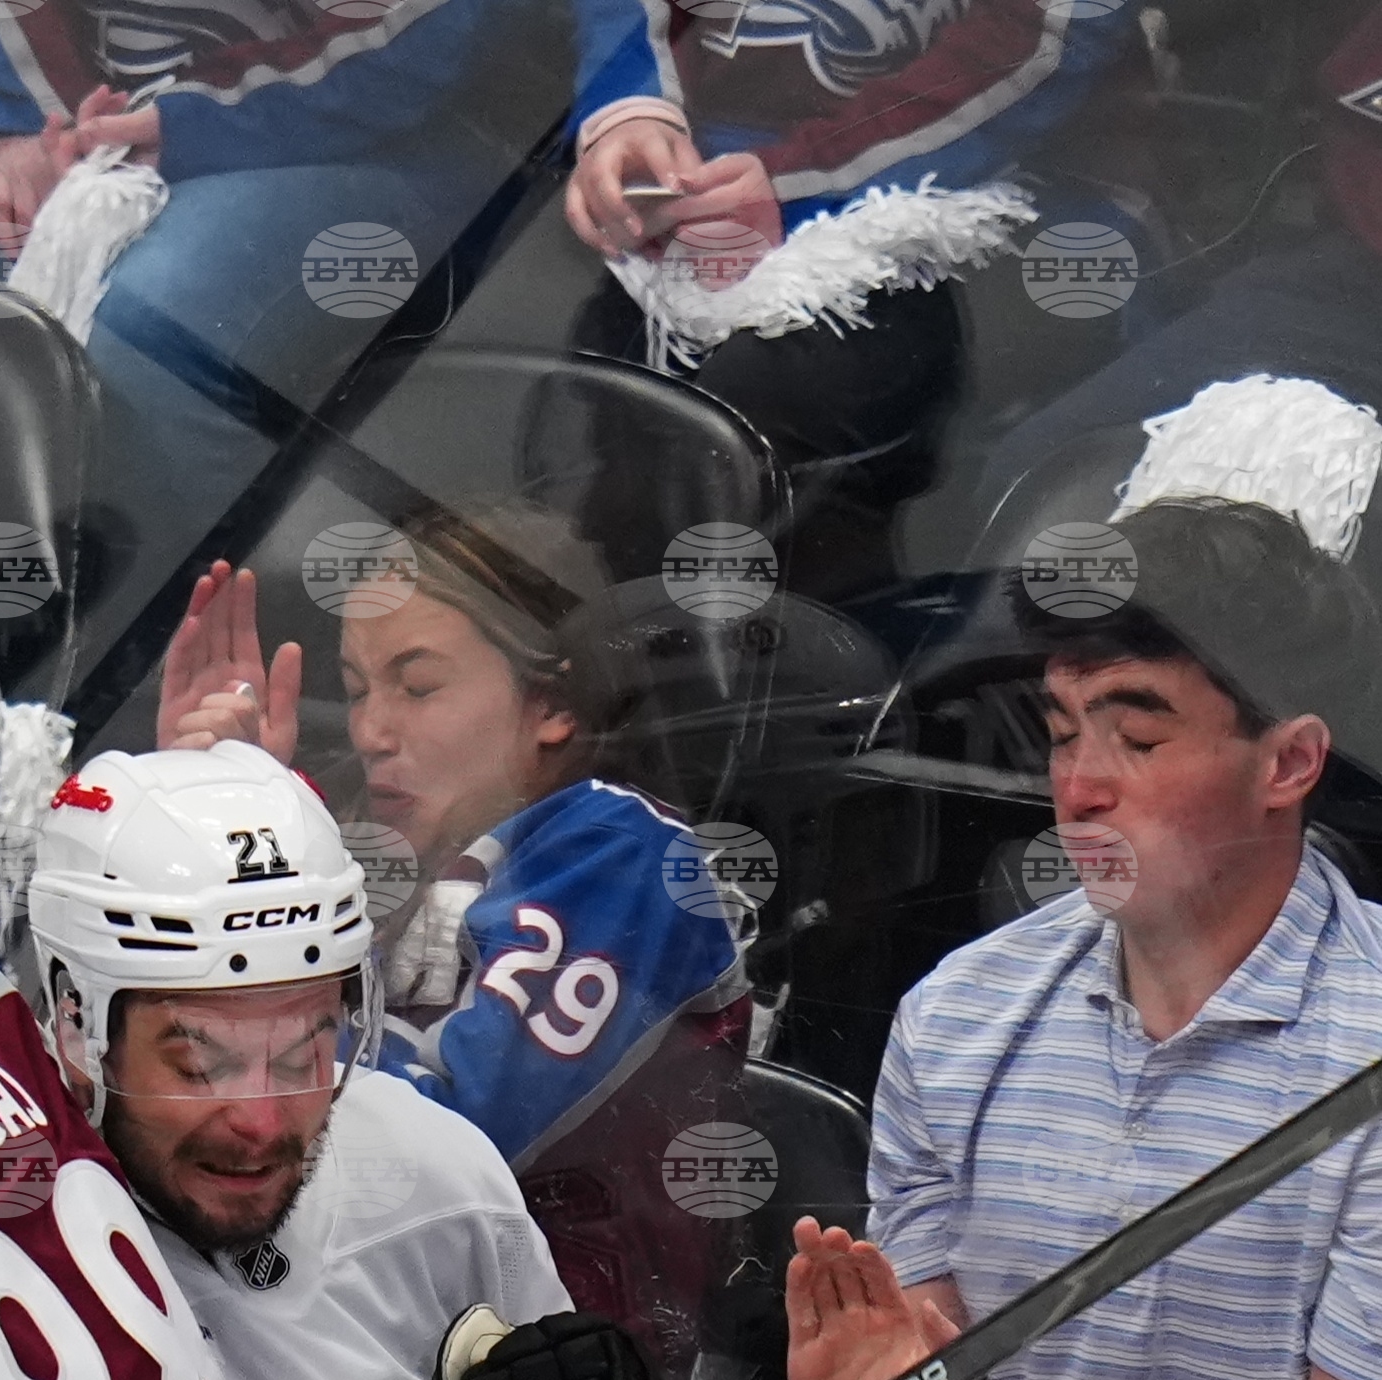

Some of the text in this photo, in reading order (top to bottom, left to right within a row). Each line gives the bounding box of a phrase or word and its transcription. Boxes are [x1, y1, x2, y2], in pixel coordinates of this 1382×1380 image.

[226, 827, 289, 879] 21
[222, 903, 320, 932] CCM
[481, 906, 620, 1057] 29
[254, 1249, 274, 1285] NHL
